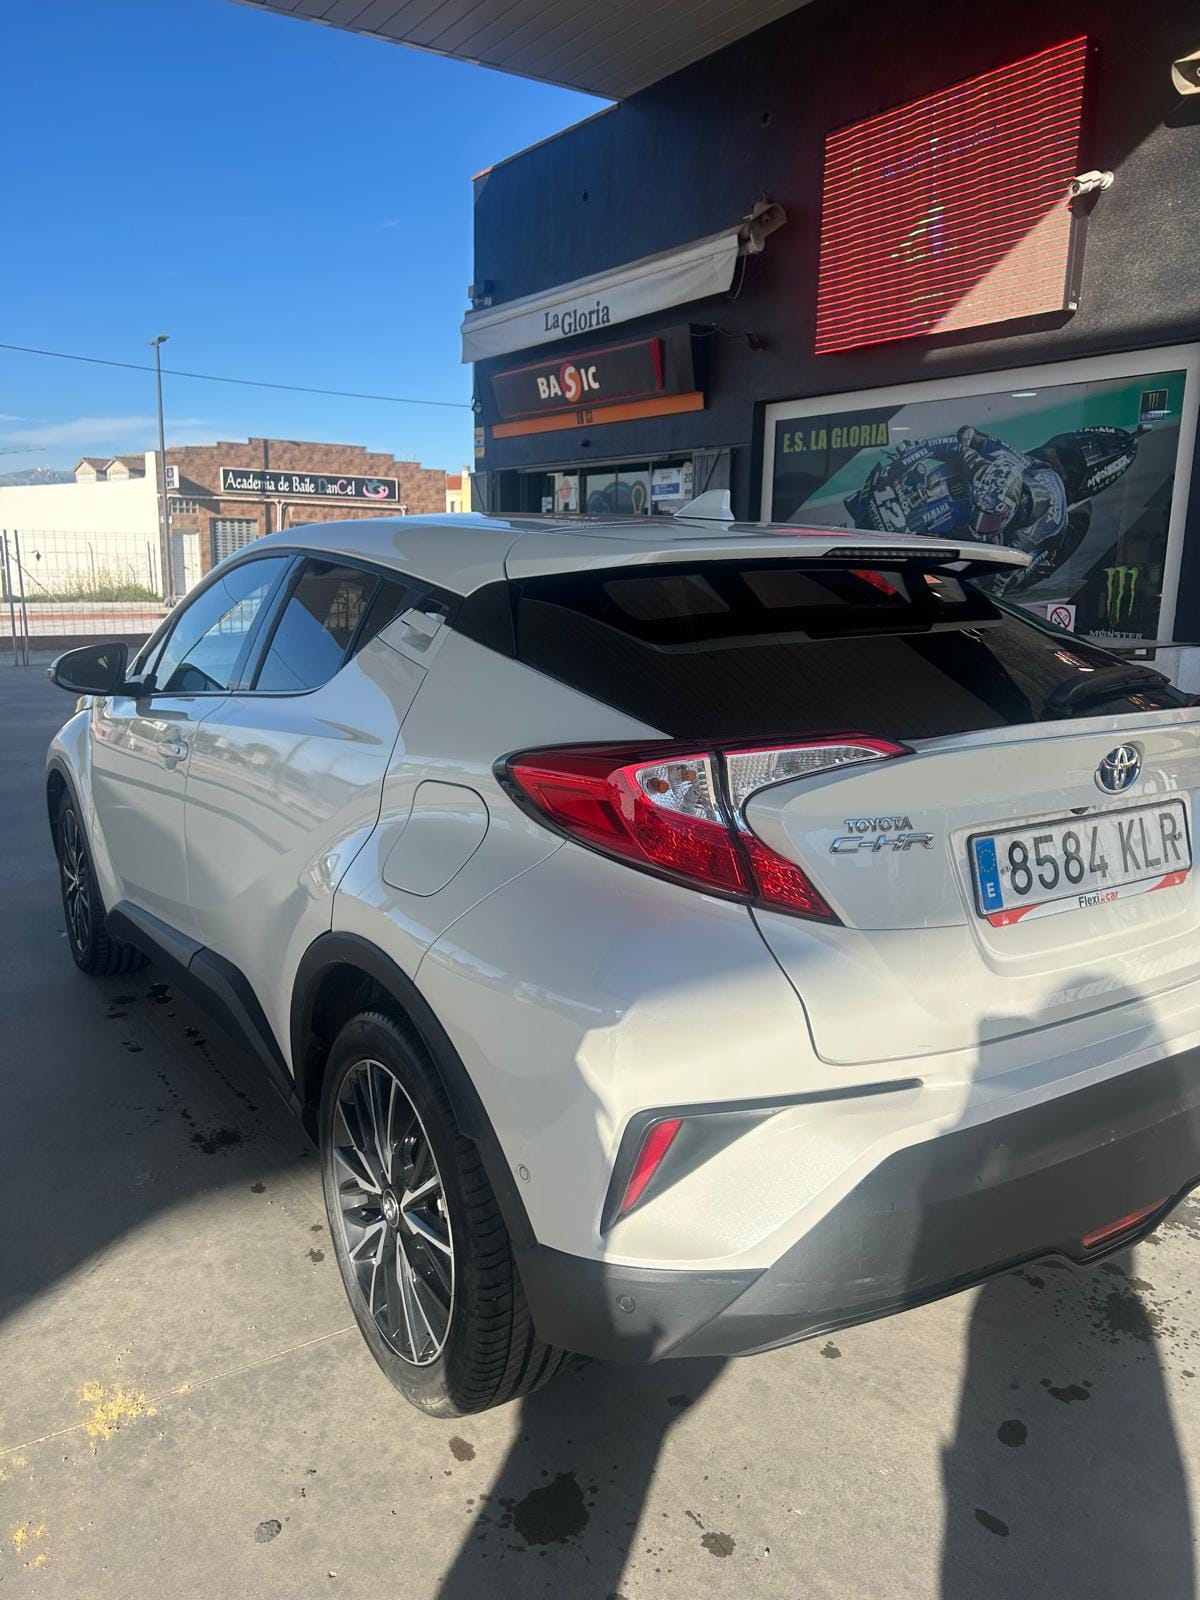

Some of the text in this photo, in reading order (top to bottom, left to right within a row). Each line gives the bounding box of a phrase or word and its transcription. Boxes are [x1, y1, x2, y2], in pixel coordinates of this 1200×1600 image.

[544, 300, 611, 336] La Gloria
[536, 365, 600, 400] BASIC
[783, 422, 888, 453] E.S. LA GLORIA
[225, 471, 356, 496] Academia de Baile DanCel
[873, 485, 906, 528] 12
[922, 502, 951, 523] YAMAHA
[844, 815, 914, 834] TOYOTA
[829, 832, 935, 855] C-HR
[1007, 811, 1183, 896] 8584 KLR
[985, 881, 997, 898] E
